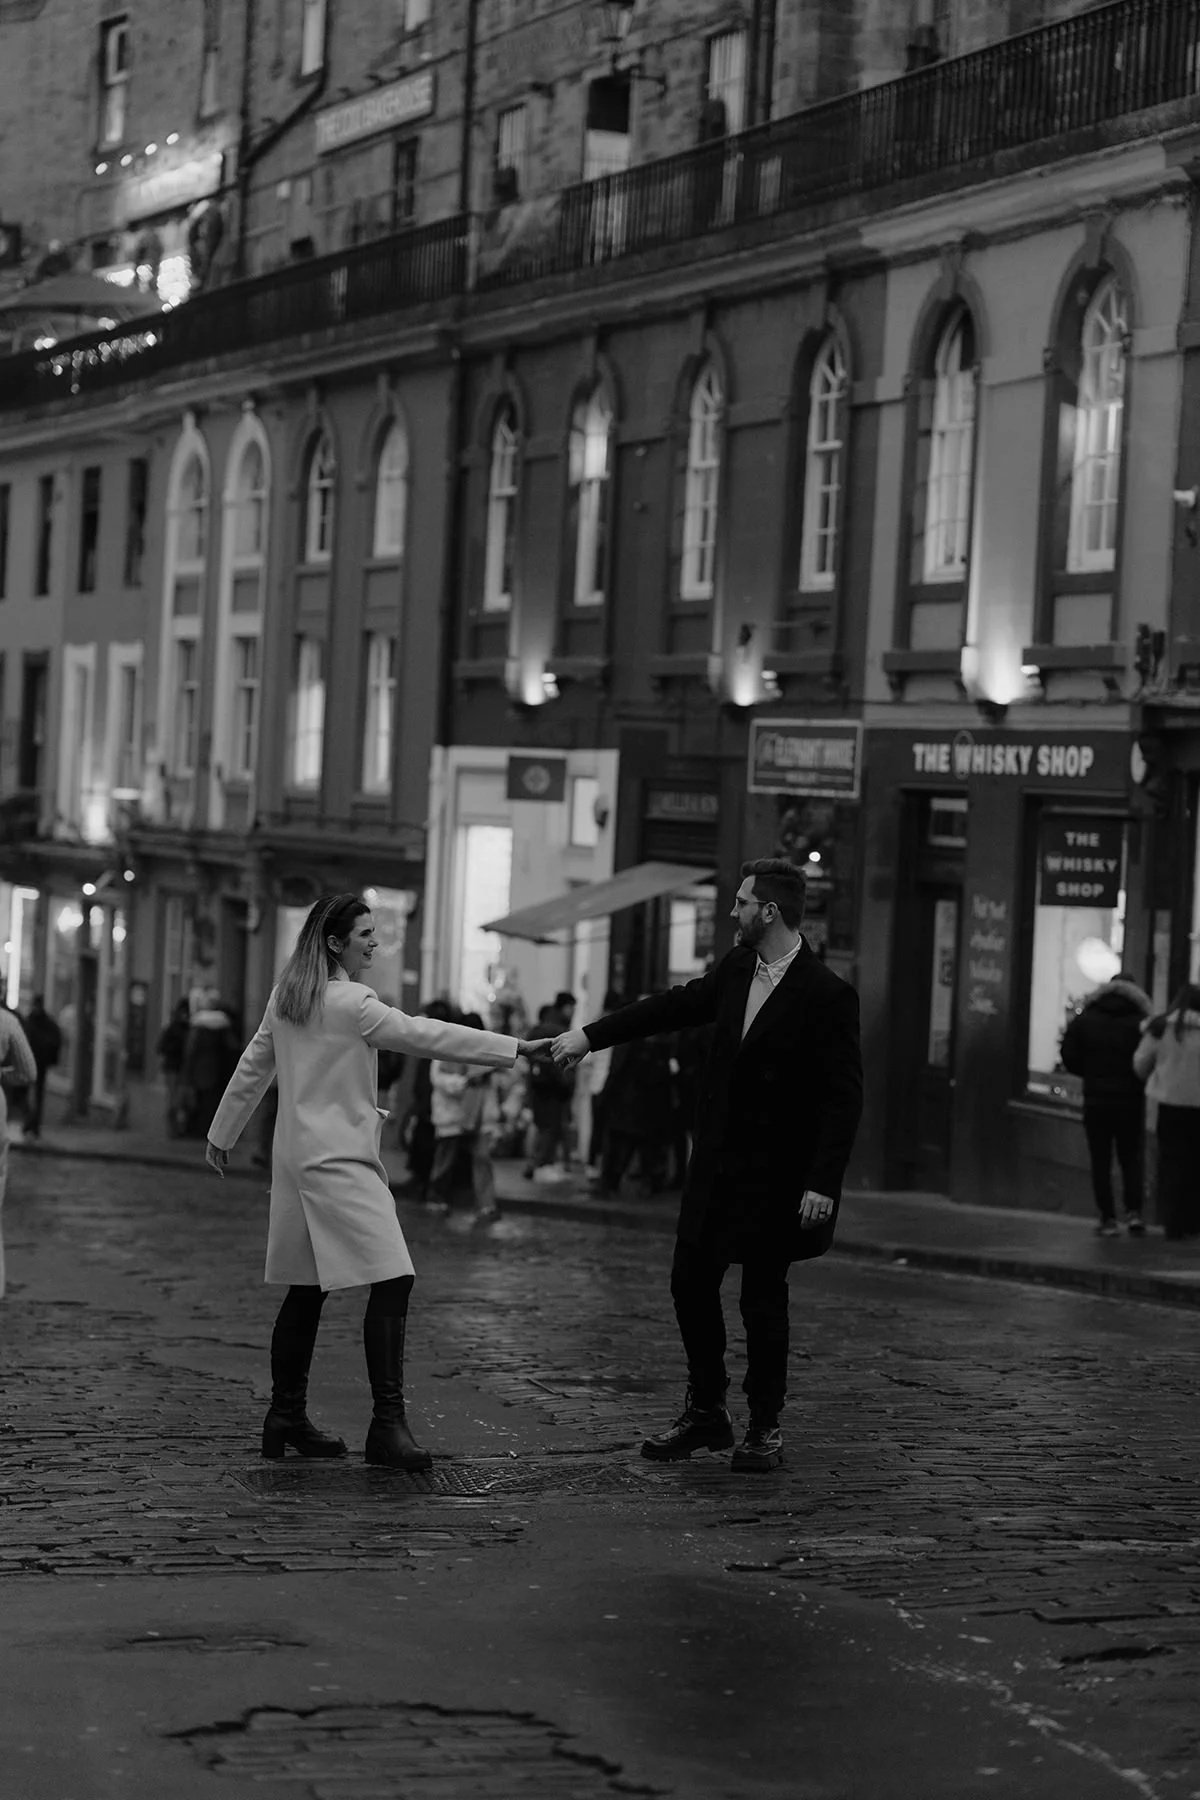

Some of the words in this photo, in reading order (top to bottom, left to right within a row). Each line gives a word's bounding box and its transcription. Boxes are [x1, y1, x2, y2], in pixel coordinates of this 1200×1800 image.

[912, 742, 950, 773] THE
[954, 743, 1033, 775] WHISKY
[1036, 744, 1094, 777] SHOP
[1064, 831, 1100, 848] THE
[1044, 855, 1118, 873] WHISKY
[1056, 881, 1104, 898] SHOP
